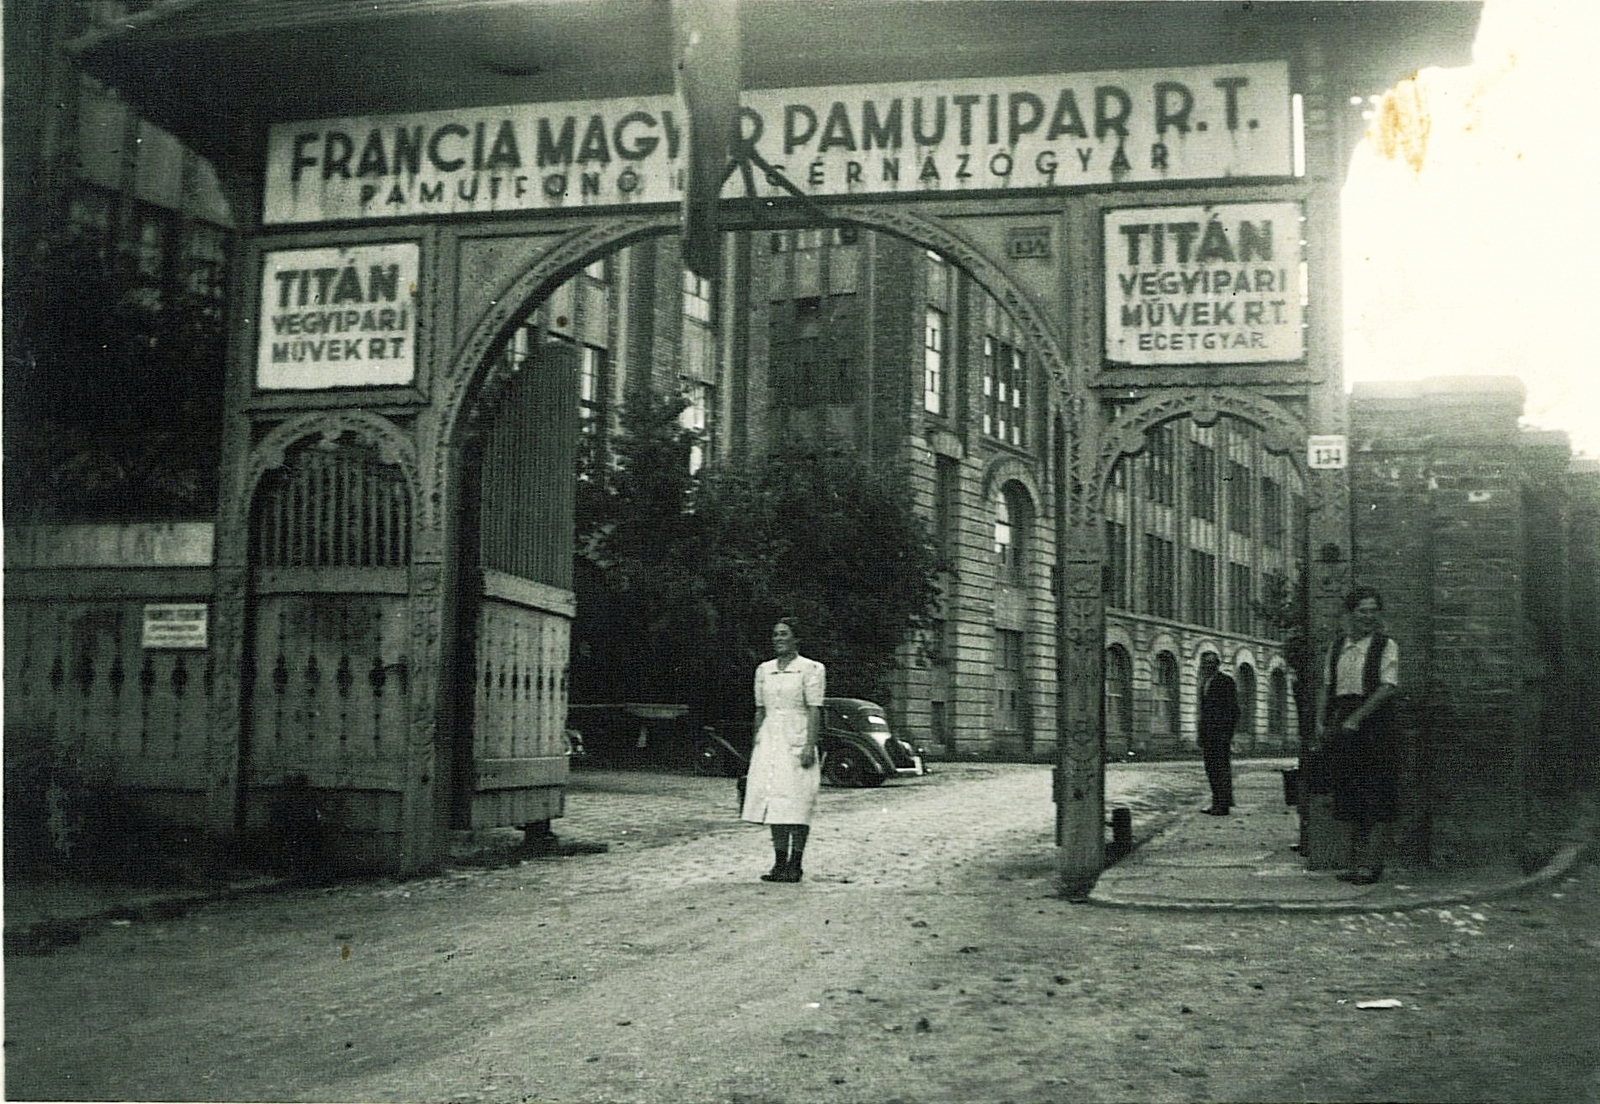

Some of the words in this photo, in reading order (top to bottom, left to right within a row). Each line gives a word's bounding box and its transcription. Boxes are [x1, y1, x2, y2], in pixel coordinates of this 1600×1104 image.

[291, 119, 520, 182] FRANCIA
[783, 84, 1132, 154] PAMUTIPAR
[1153, 76, 1259, 134] R.T.
[1119, 213, 1273, 266] TITÁN
[275, 258, 400, 308] TITÁN
[1118, 268, 1287, 296] VEGYIPARI
[272, 308, 408, 335] VEGYIPARI
